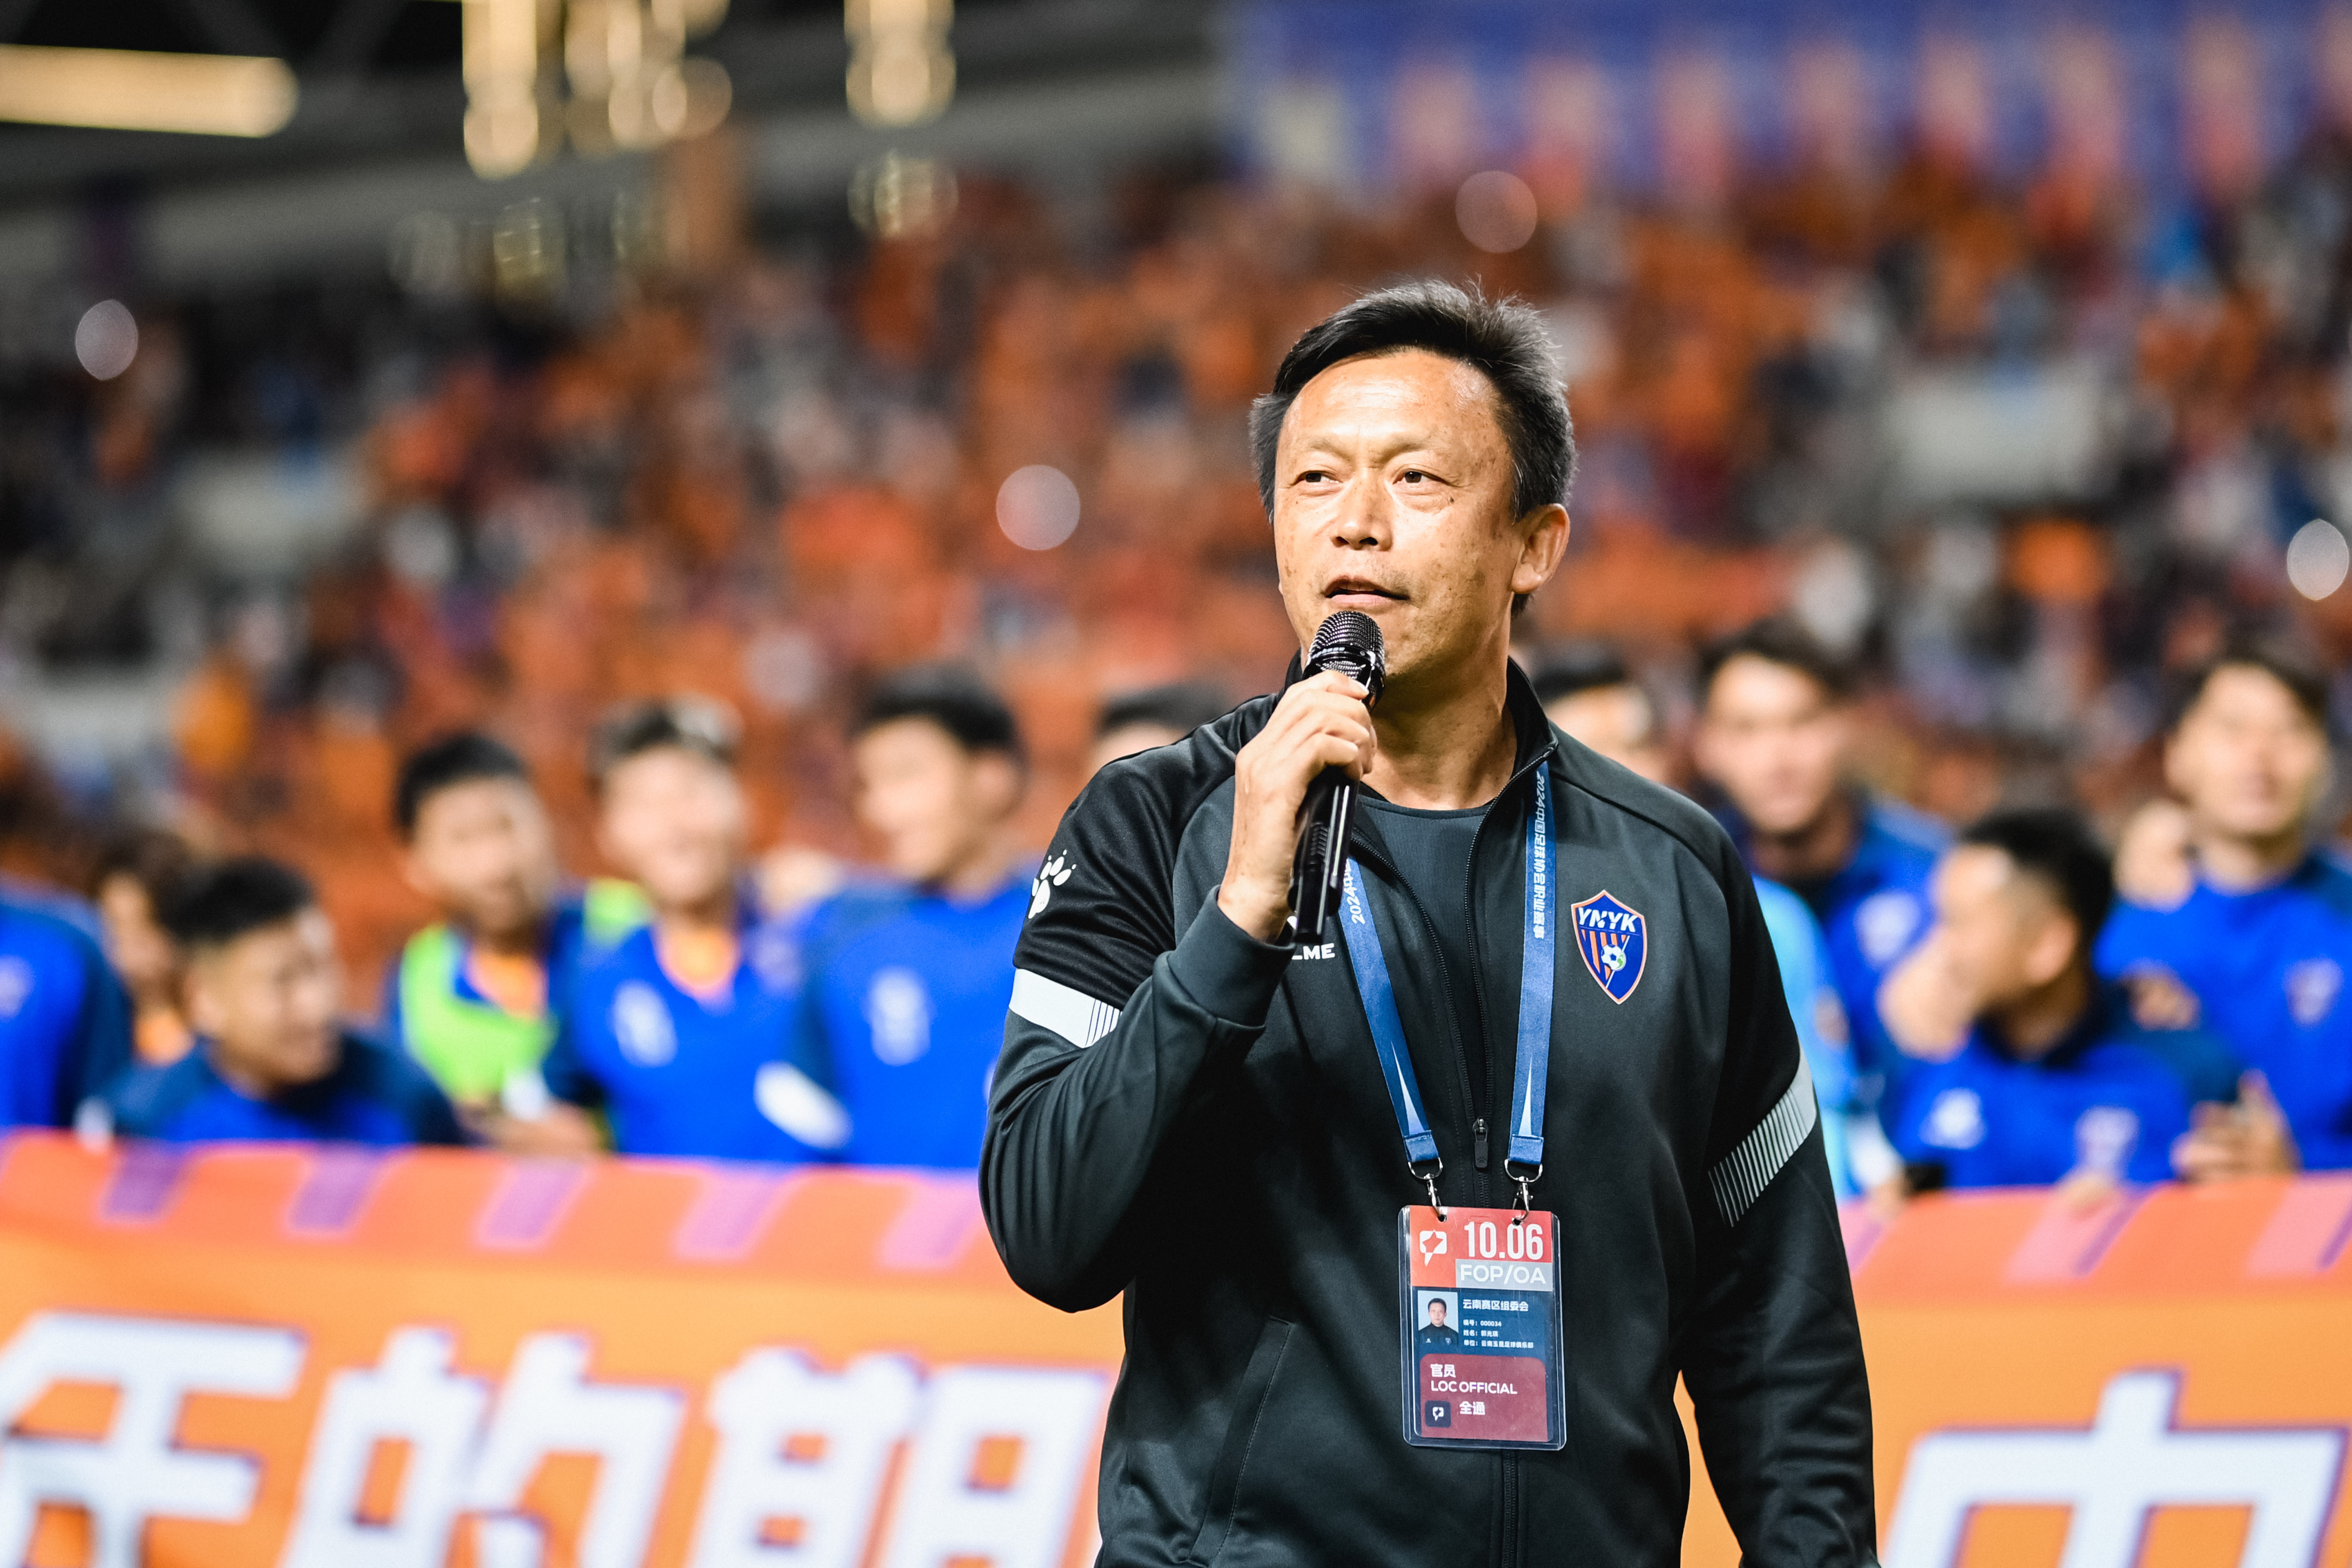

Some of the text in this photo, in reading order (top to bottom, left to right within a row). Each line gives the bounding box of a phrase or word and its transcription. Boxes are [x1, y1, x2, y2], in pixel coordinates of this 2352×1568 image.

[1343, 858, 1365, 924] 2024中
[1578, 907, 1638, 933] YNYK
[1464, 1221, 1543, 1260] 10.06
[1460, 1264, 1546, 1284] FOP/OA
[1463, 1299, 1528, 1312] 云南赛区组委会
[1430, 1363, 1456, 1377] 官员
[1431, 1380, 1517, 1394] LOC OFFICIAL
[1459, 1401, 1485, 1415] 全通
